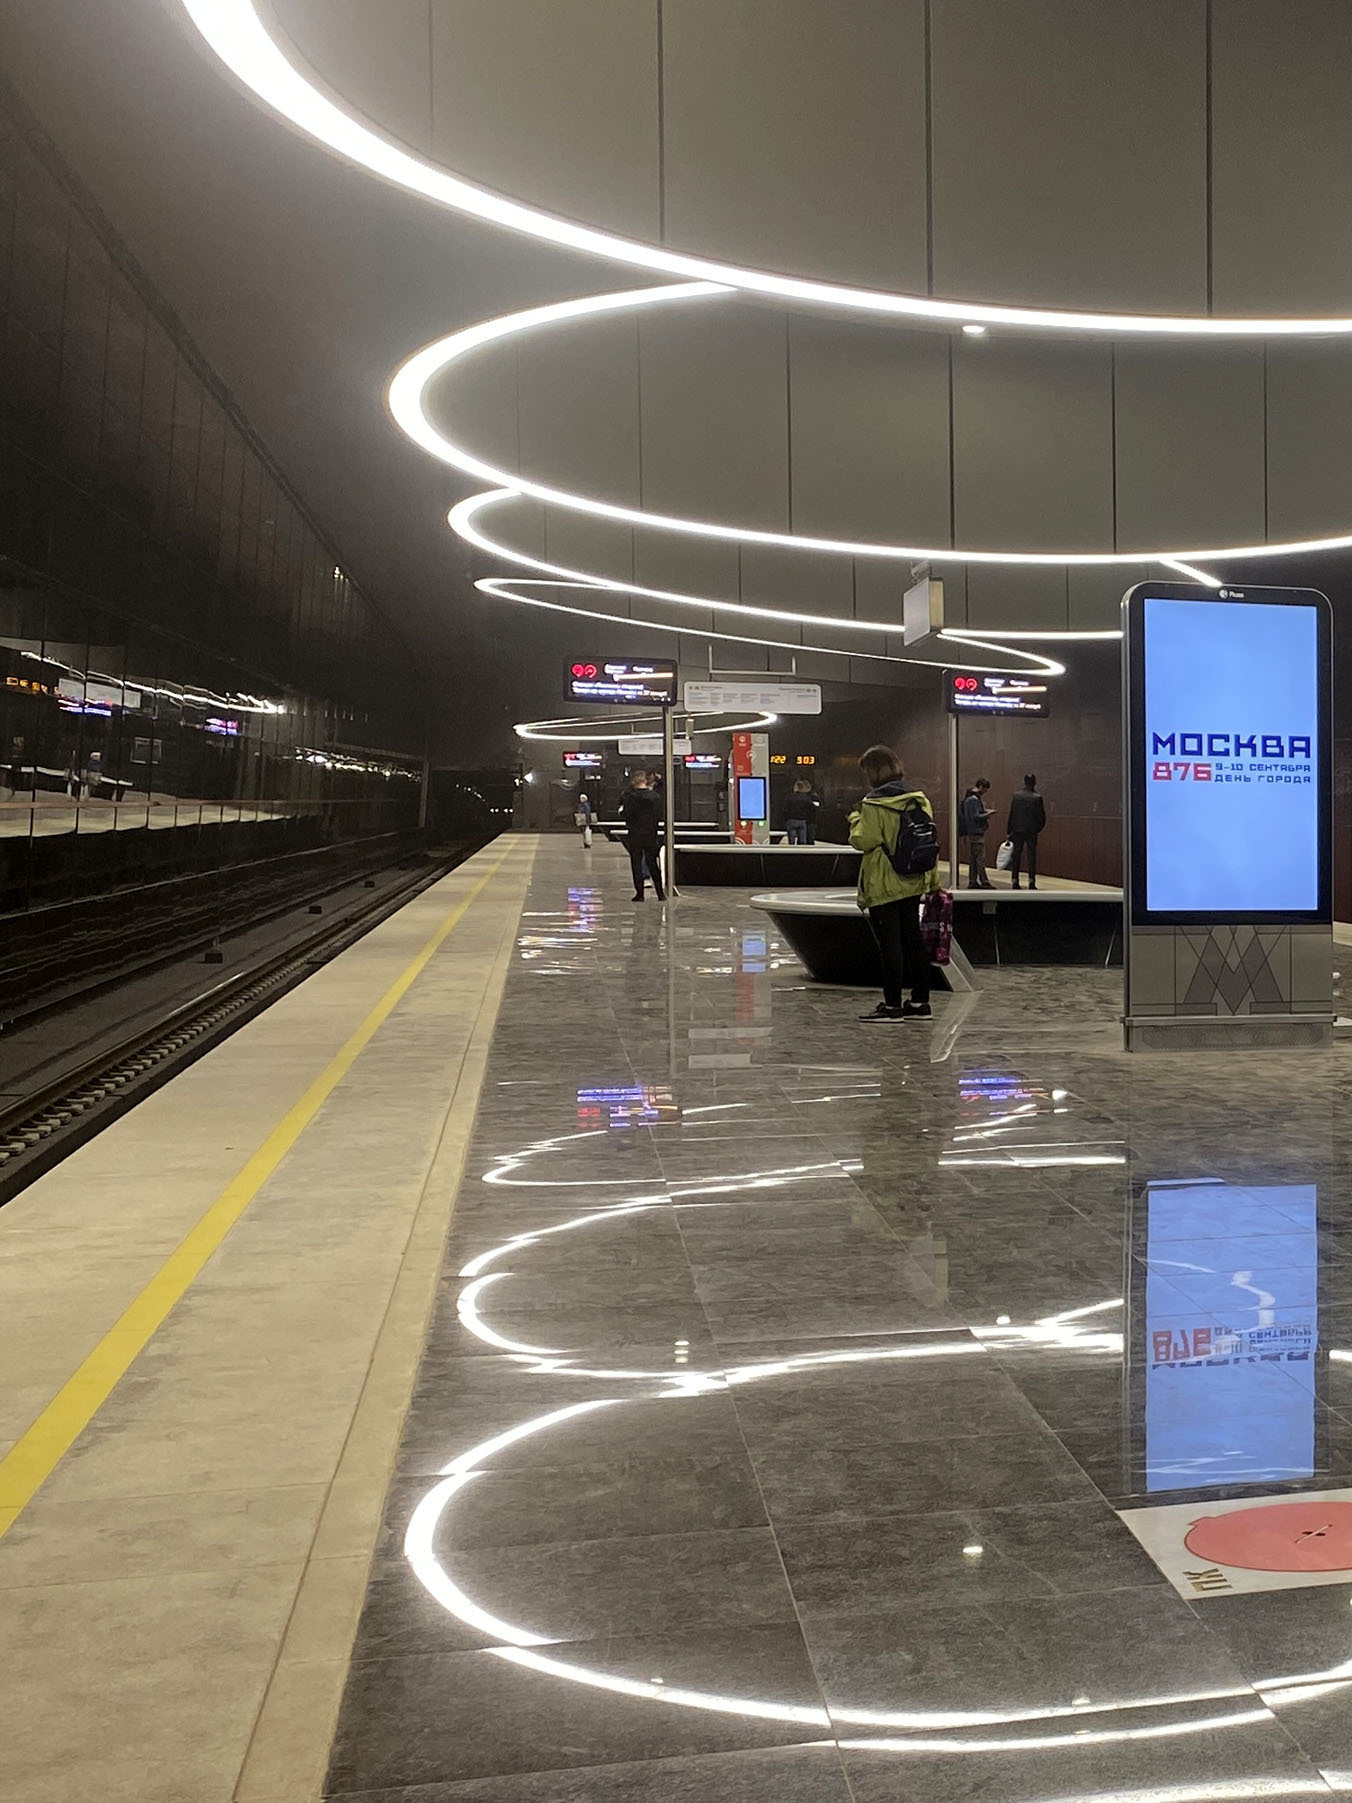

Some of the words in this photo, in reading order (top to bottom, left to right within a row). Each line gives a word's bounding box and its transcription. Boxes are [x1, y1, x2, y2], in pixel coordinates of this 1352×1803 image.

[1152, 732, 1311, 759] МОСКВА
[1152, 762, 1212, 781] 876
[1249, 763, 1311, 773] СЕНТЯБРЯ
[1214, 774, 1251, 783] ДЕНЬ
[1258, 775, 1311, 784] ГОРОДА
